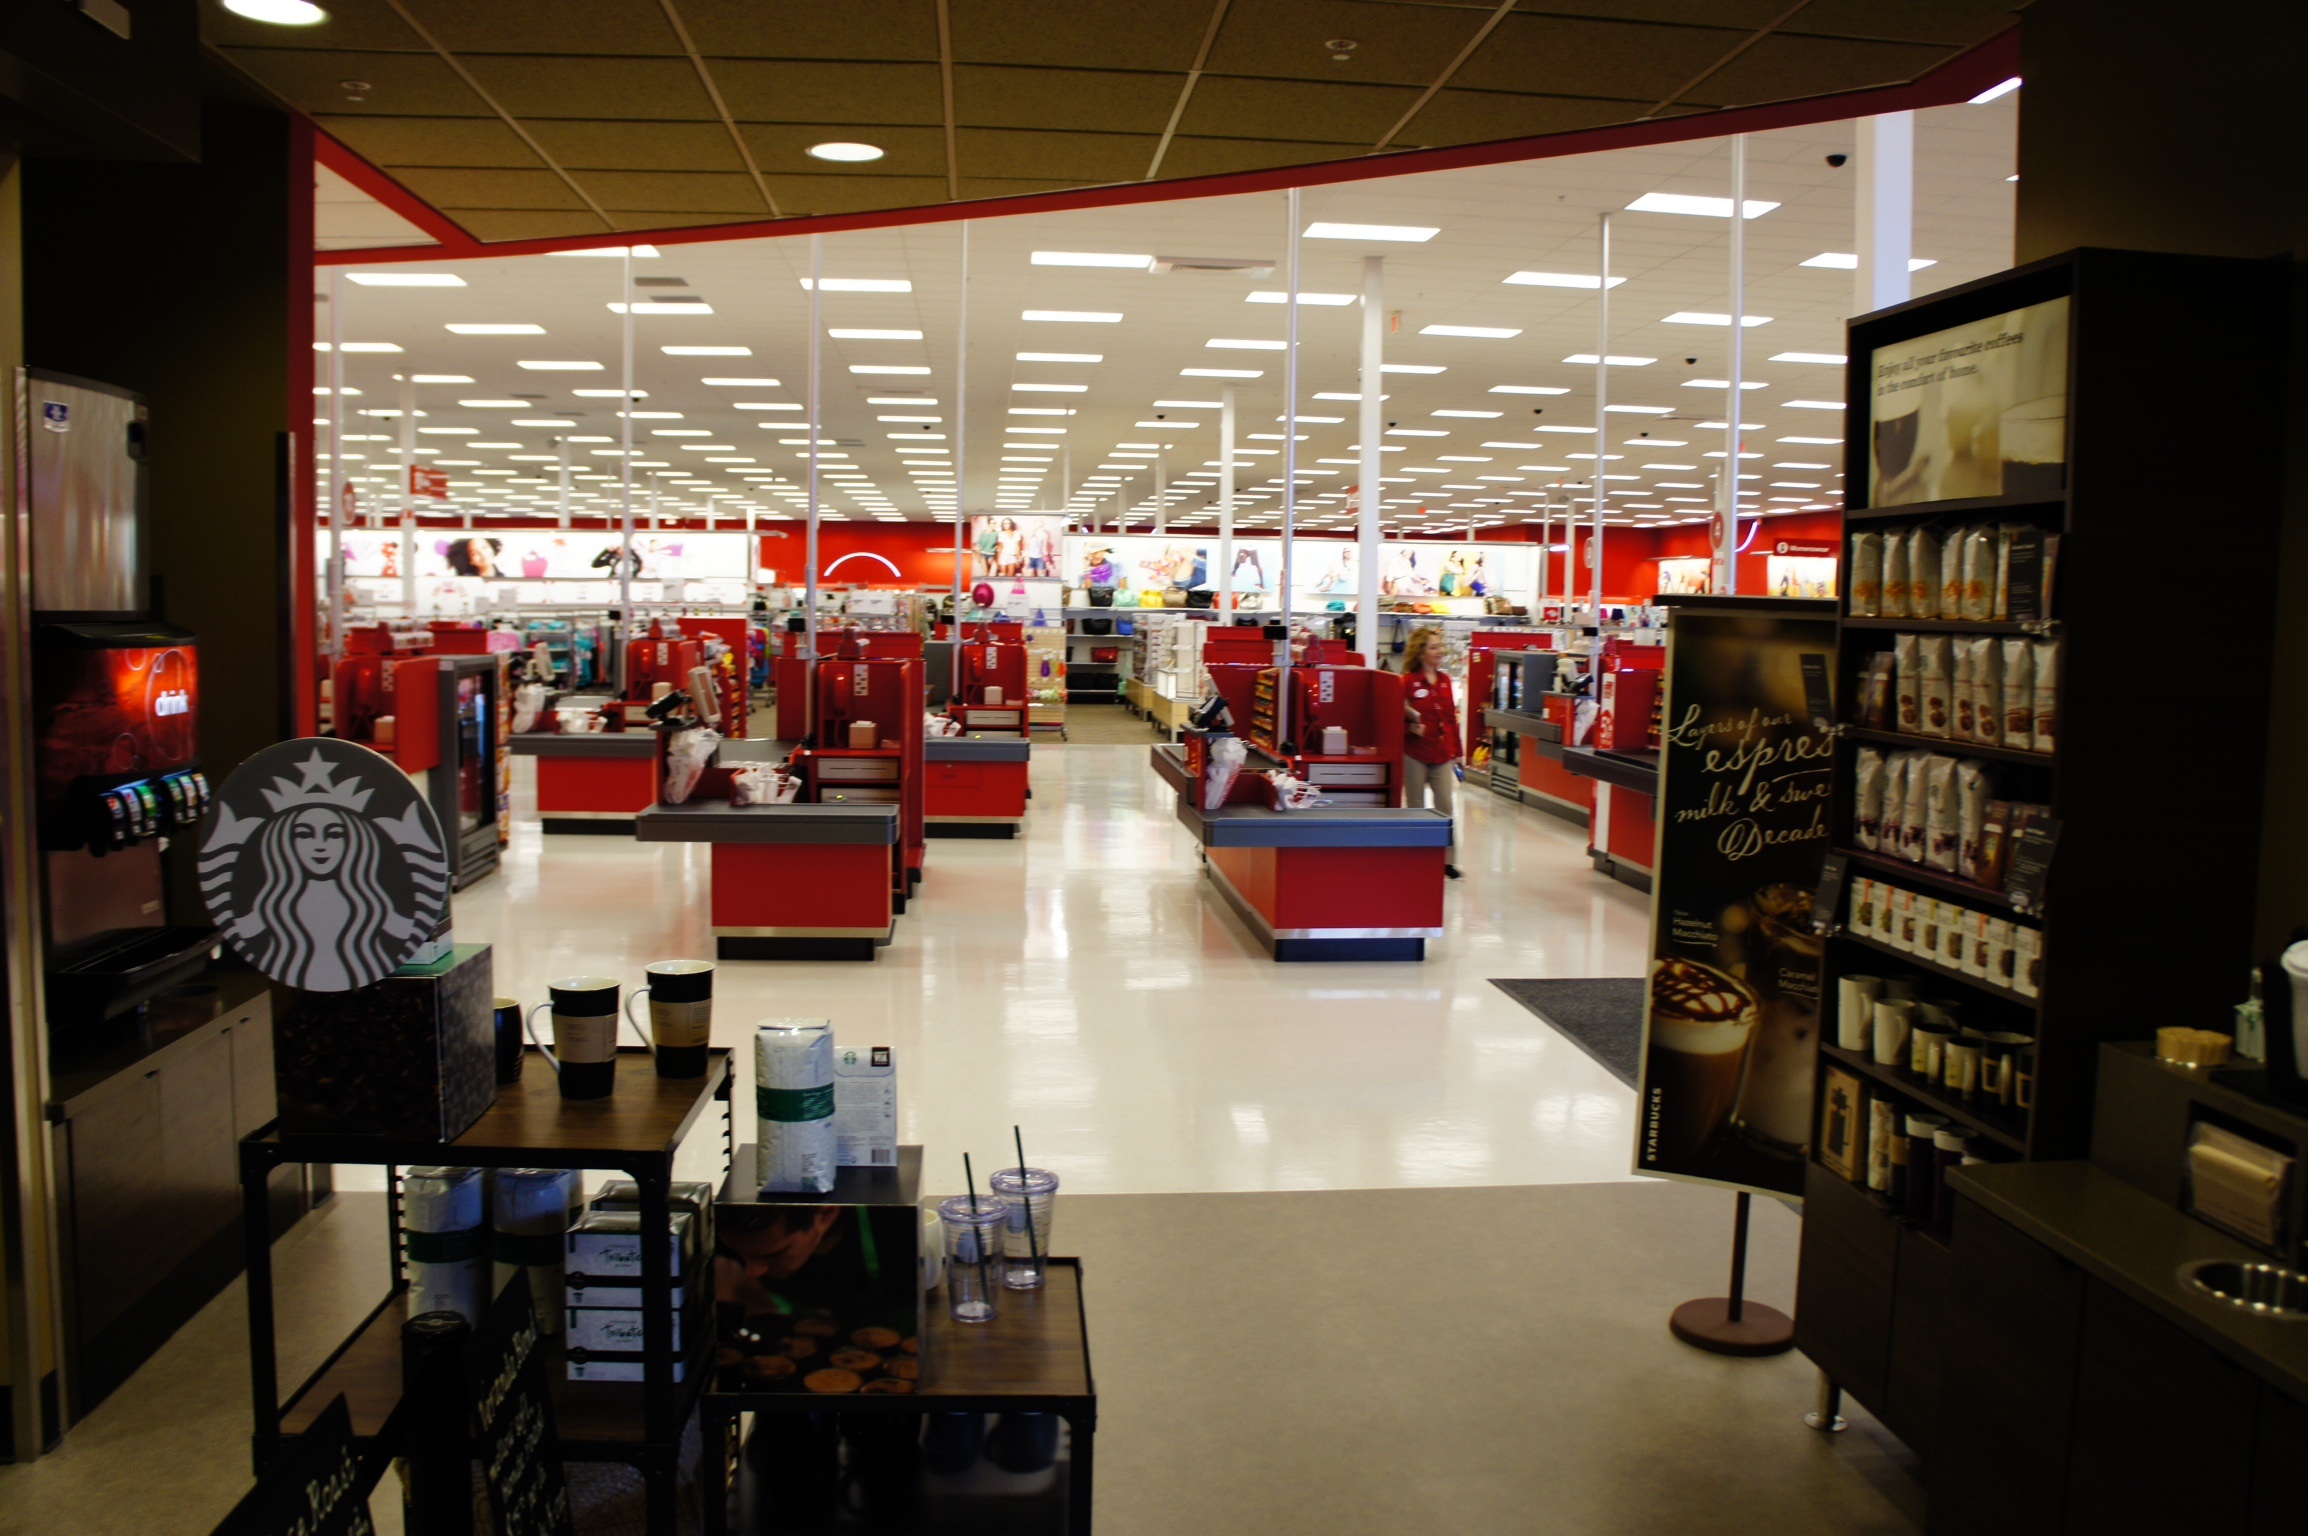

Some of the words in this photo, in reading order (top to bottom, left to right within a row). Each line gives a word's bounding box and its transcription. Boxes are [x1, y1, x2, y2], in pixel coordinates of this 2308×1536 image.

[1878, 362, 1901, 378] Enjoy
[1902, 356, 1915, 371] all
[1915, 354, 1937, 370] your
[1938, 341, 1983, 363] favourite
[1983, 332, 2024, 351] coffees
[155, 689, 189, 717] drink
[1667, 703, 1734, 751] Layers
[1737, 707, 1760, 741] of
[1761, 713, 1793, 728] our
[1674, 781, 1741, 823] milk
[1749, 781, 1777, 813] &
[1646, 1087, 1663, 1163] STARBUCKS
